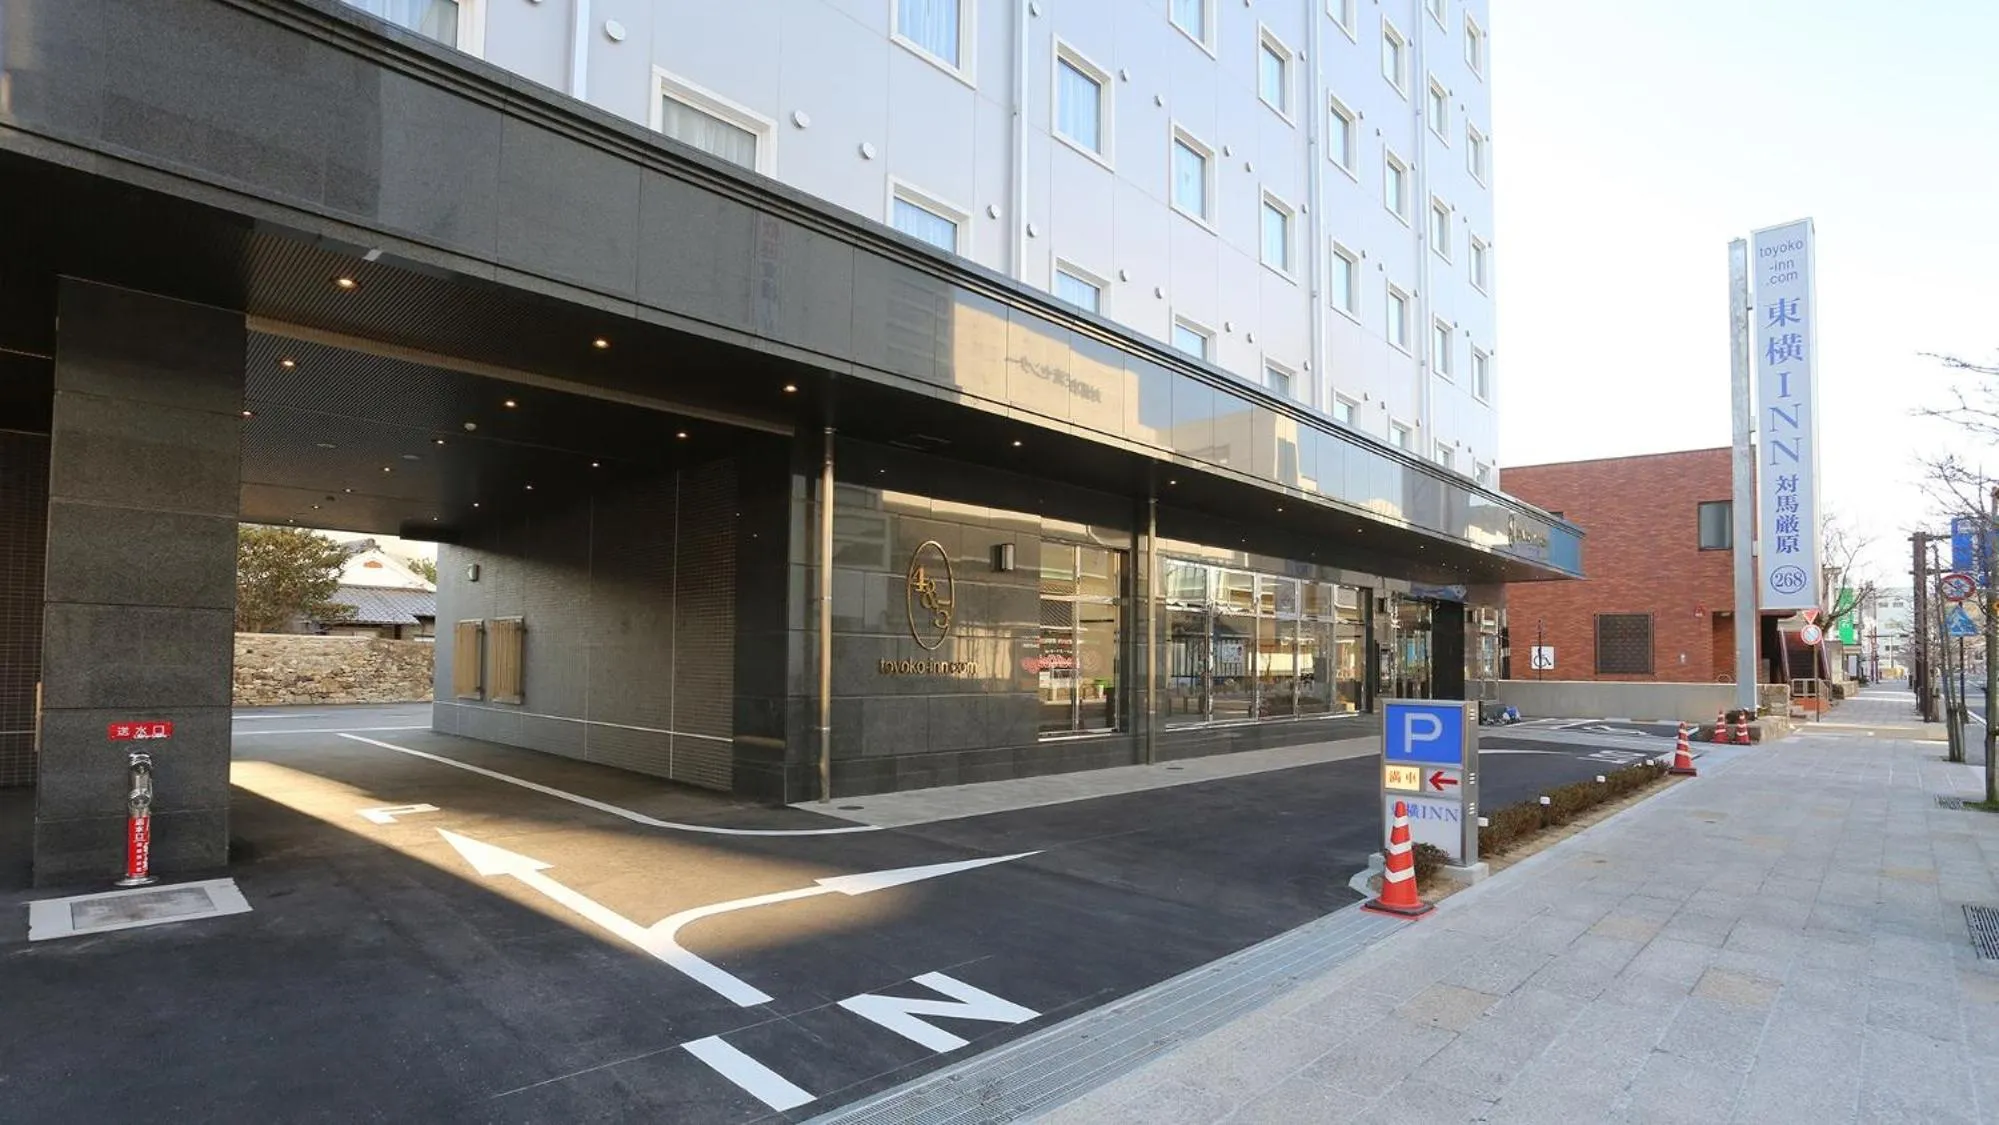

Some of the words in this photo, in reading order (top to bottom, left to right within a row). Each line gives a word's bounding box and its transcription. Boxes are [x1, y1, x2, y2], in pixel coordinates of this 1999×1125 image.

[1760, 240, 1804, 258] toyoko
[1769, 259, 1795, 271] -inn
[1766, 271, 1799, 286] .com
[1765, 298, 1803, 466] 東横INN
[1775, 474, 1800, 553] 対馬厳原
[1774, 572, 1804, 589] 268
[117, 725, 166, 739] 送水口
[1404, 712, 1443, 753] P
[1392, 801, 1459, 822] 横INN
